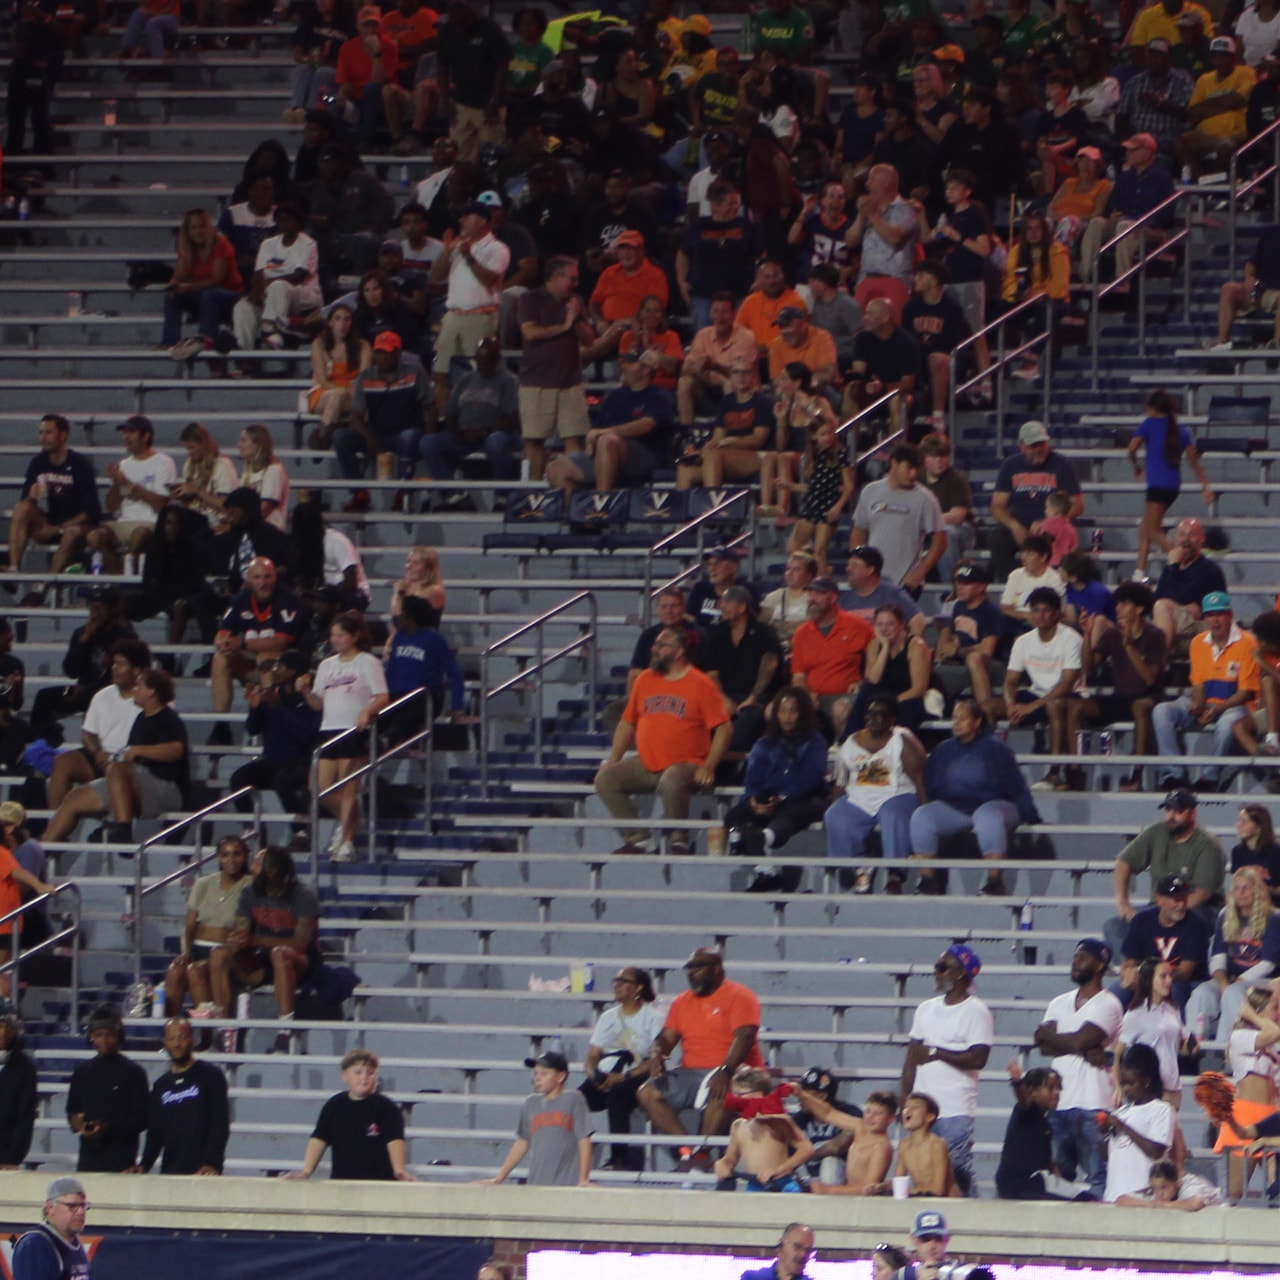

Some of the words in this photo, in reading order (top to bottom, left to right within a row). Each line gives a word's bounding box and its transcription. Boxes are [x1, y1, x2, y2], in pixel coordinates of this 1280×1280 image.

[651, 491, 671, 510] V
[644, 694, 688, 719] VIRGINIA
[1154, 937, 1178, 961] V
